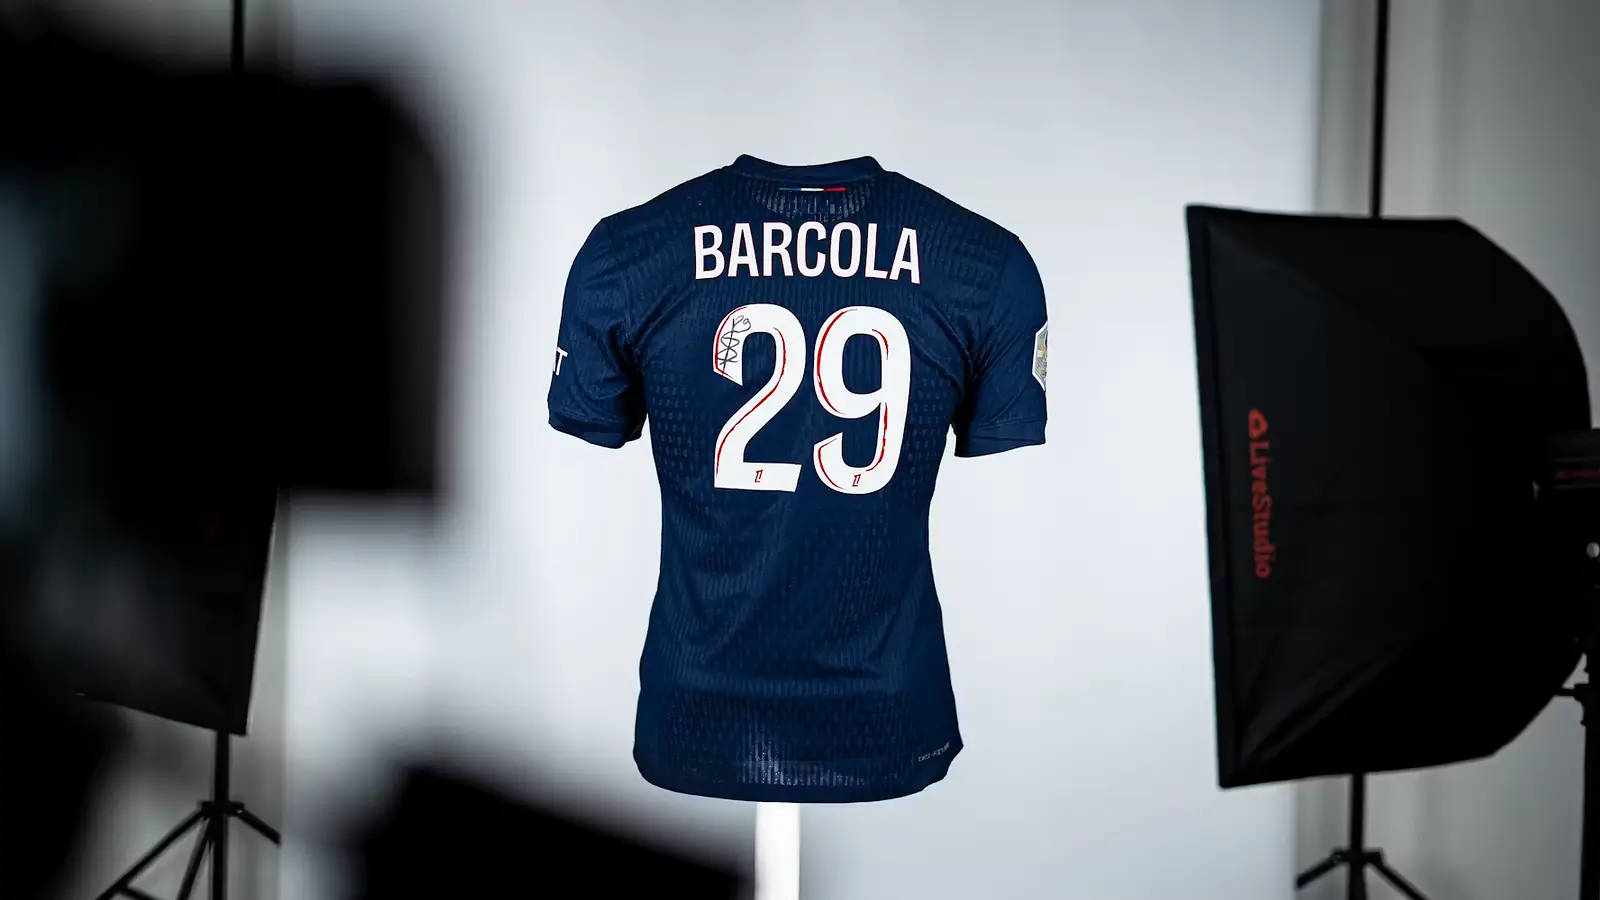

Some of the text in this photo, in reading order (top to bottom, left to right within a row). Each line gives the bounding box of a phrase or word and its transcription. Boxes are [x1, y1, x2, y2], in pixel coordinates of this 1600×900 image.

[693, 221, 922, 285] BARCOLA
[712, 303, 912, 495] 29
[1250, 441, 1276, 578] LiveStudio
